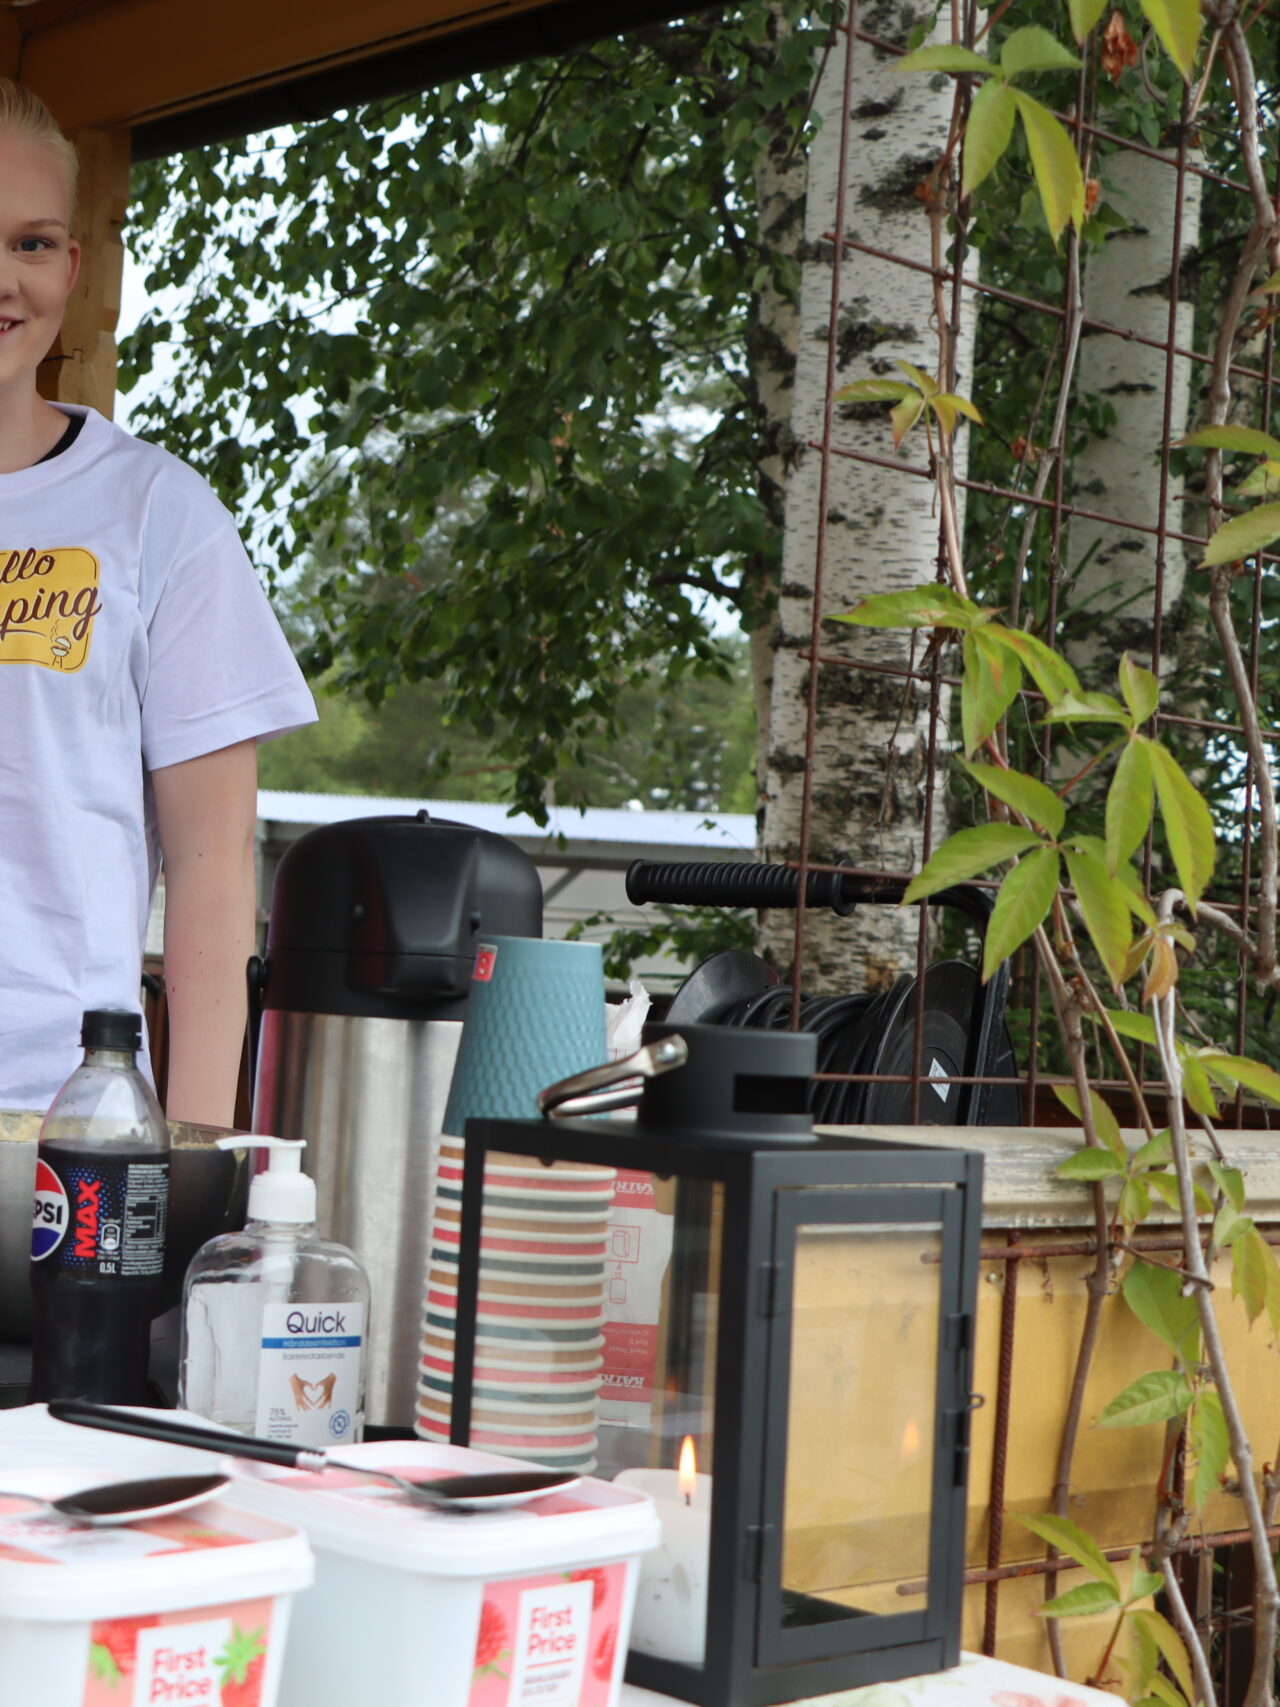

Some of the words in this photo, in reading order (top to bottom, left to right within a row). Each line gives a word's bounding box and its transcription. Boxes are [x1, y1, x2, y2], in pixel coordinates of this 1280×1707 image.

[33, 1199, 64, 1225] PSI
[74, 1179, 102, 1259] MAX
[286, 1310, 347, 1334] Quick
[530, 1602, 574, 1631] First
[526, 1630, 577, 1658] Price
[151, 1644, 207, 1674] First
[148, 1674, 213, 1703] Price
